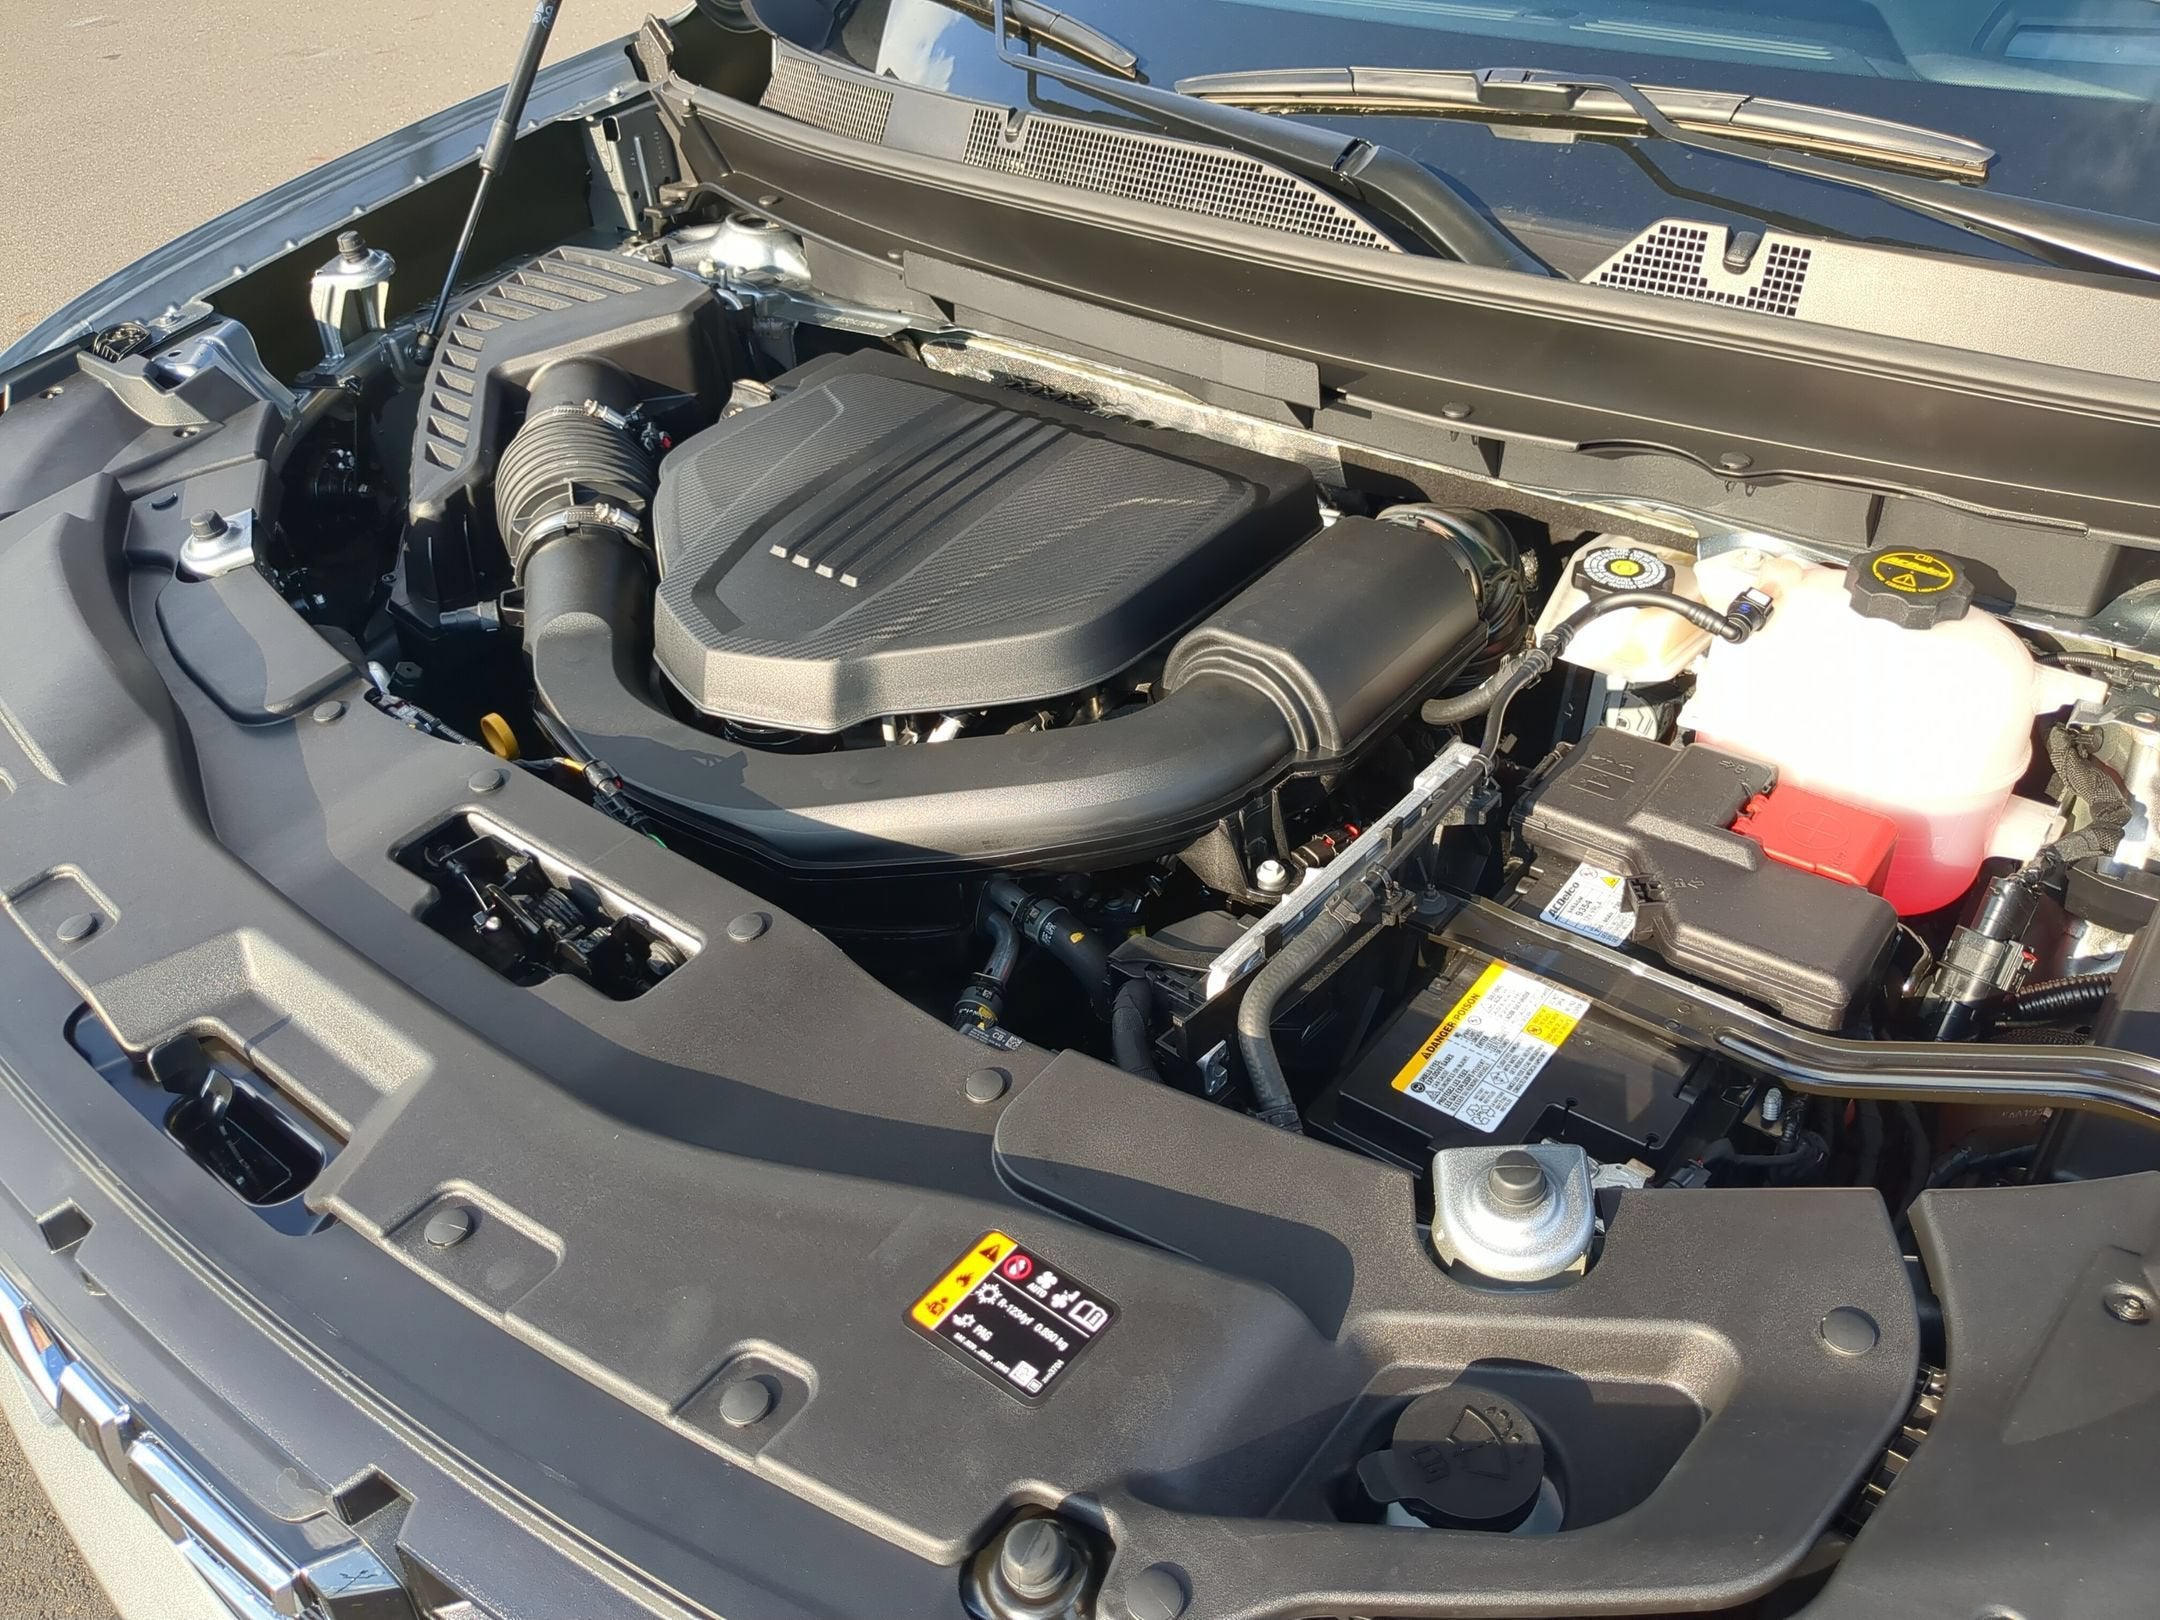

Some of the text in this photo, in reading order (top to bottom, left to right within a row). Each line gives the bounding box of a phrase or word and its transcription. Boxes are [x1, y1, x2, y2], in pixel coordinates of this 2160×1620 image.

[1549, 882, 1579, 916] ACDelco
[1027, 1283, 1047, 1298] AUTO
[973, 1325, 994, 1341] PAG
[997, 1299, 1033, 1326] R-1234yf
[1055, 1338, 1070, 1351] kg
